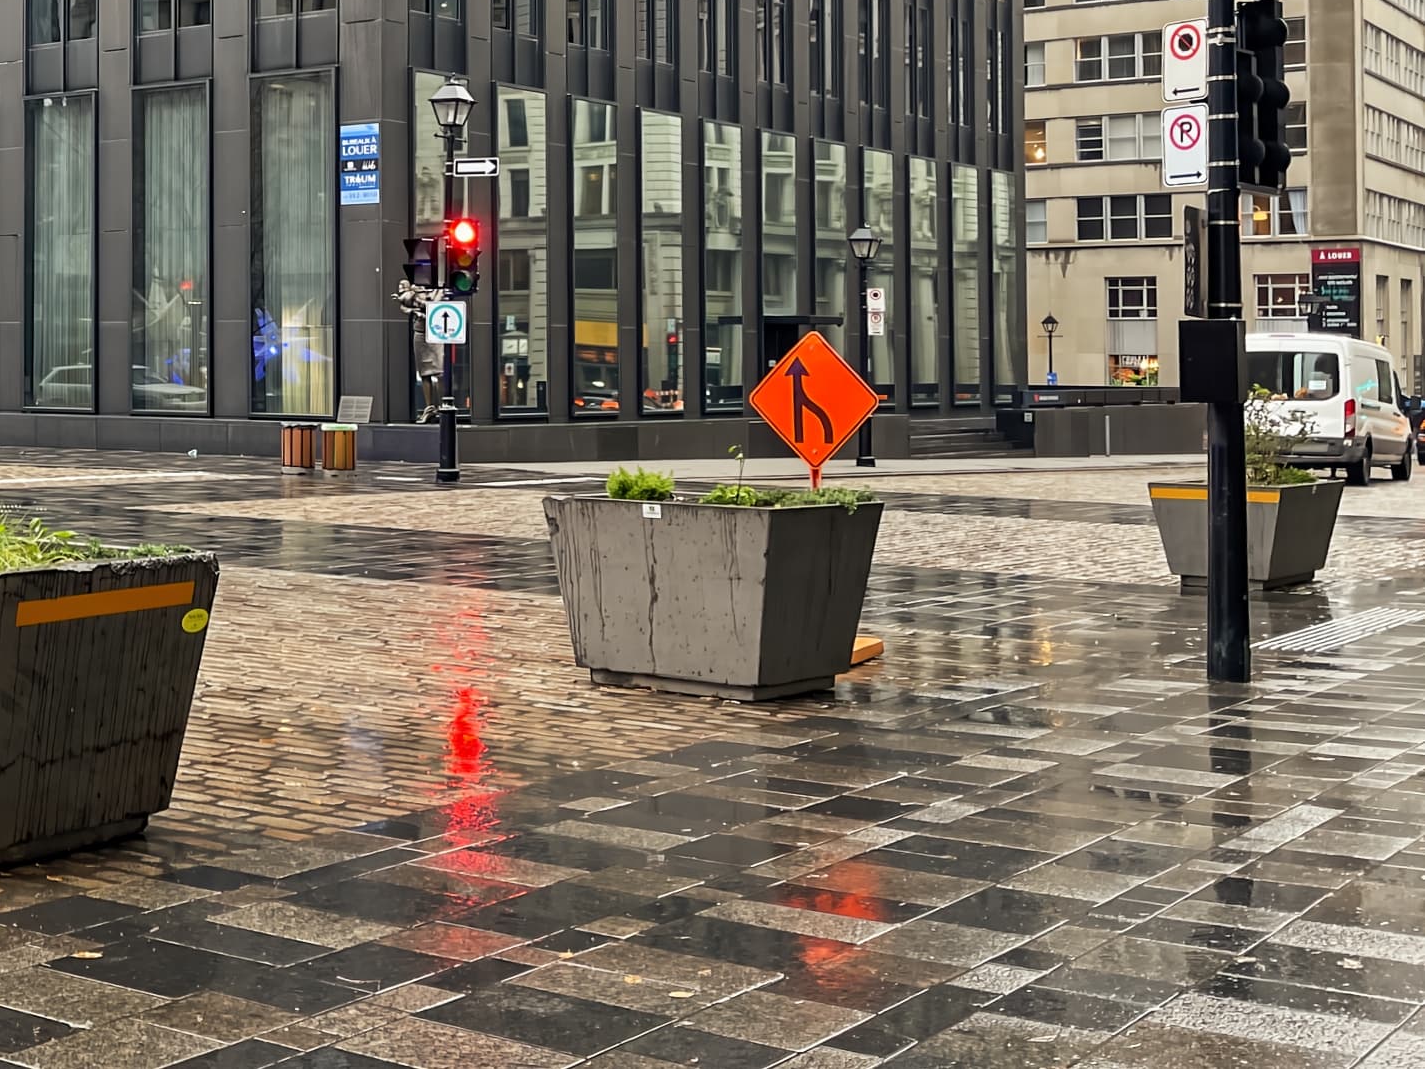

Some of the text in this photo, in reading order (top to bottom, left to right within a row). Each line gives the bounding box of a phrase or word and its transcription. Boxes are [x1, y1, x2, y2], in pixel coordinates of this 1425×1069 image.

[1180, 121, 1192, 143] P
[342, 144, 377, 157] LOUER
[1327, 251, 1352, 260] LOUER
